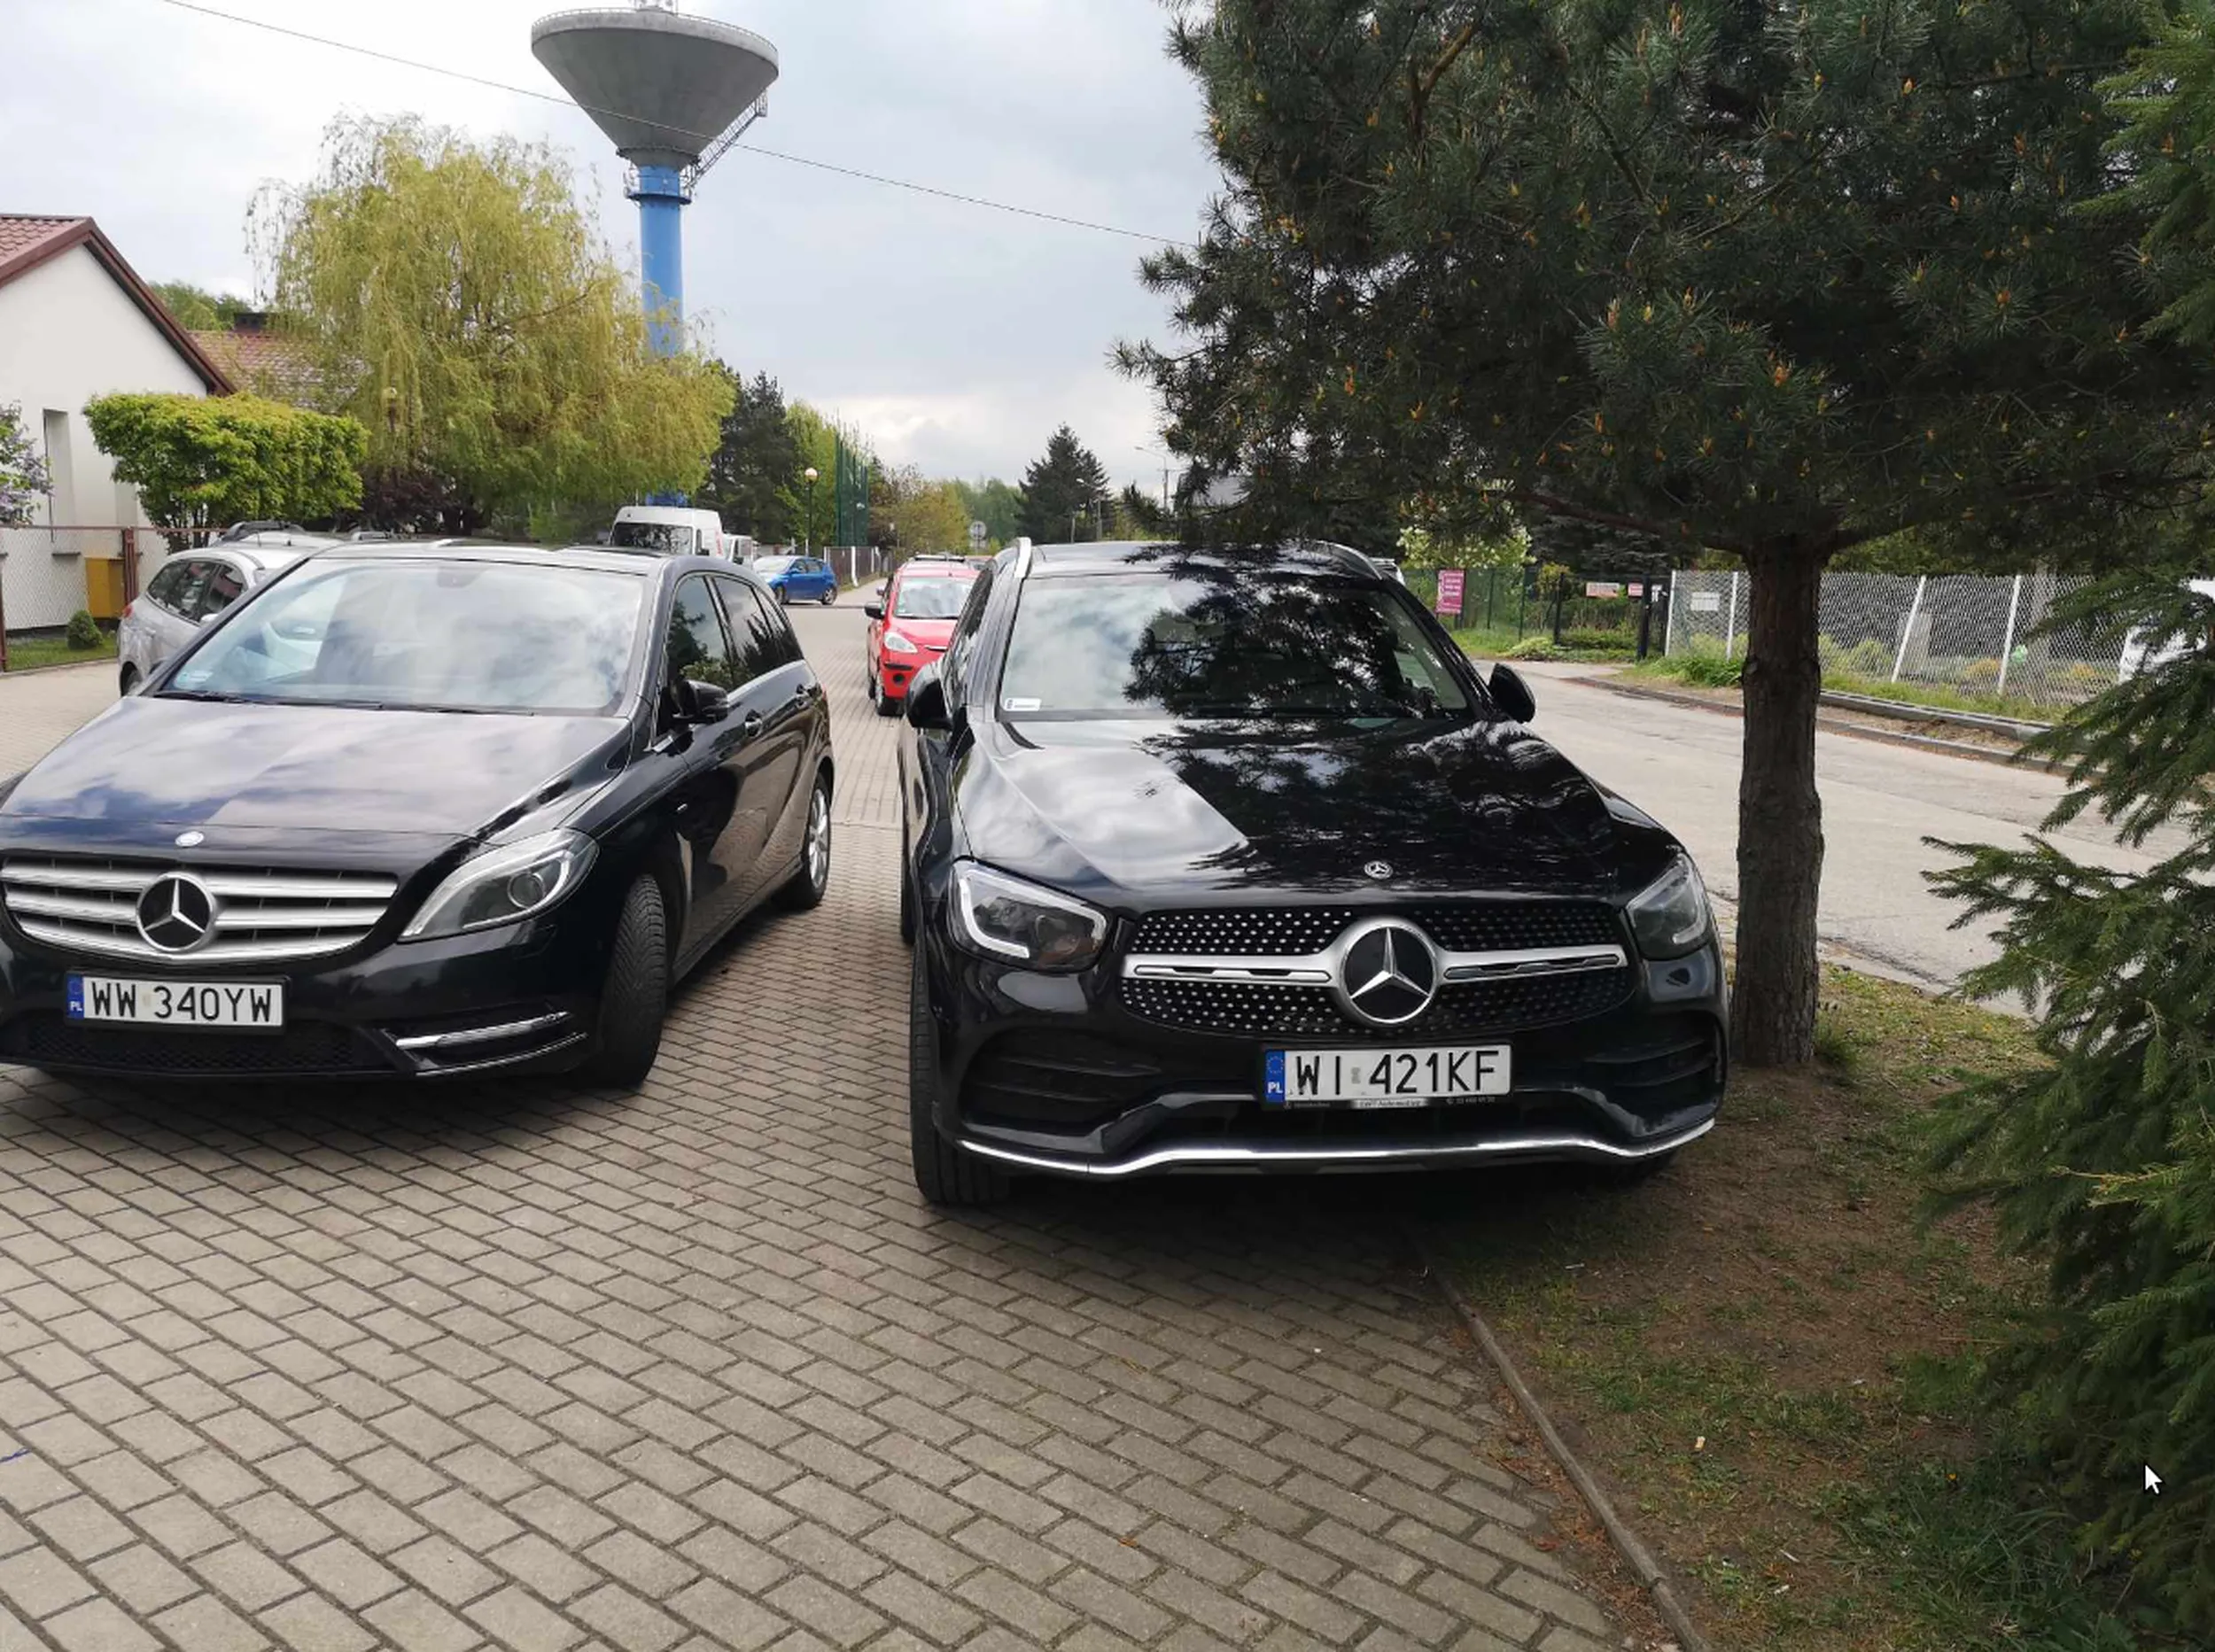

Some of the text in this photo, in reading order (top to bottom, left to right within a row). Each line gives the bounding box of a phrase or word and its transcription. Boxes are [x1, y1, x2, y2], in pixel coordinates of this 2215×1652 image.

[70, 1001, 82, 1012] PL
[91, 981, 271, 1022] WW 340YW
[1296, 1051, 1499, 1096] WI 421KF
[1268, 1082, 1283, 1094] PL
